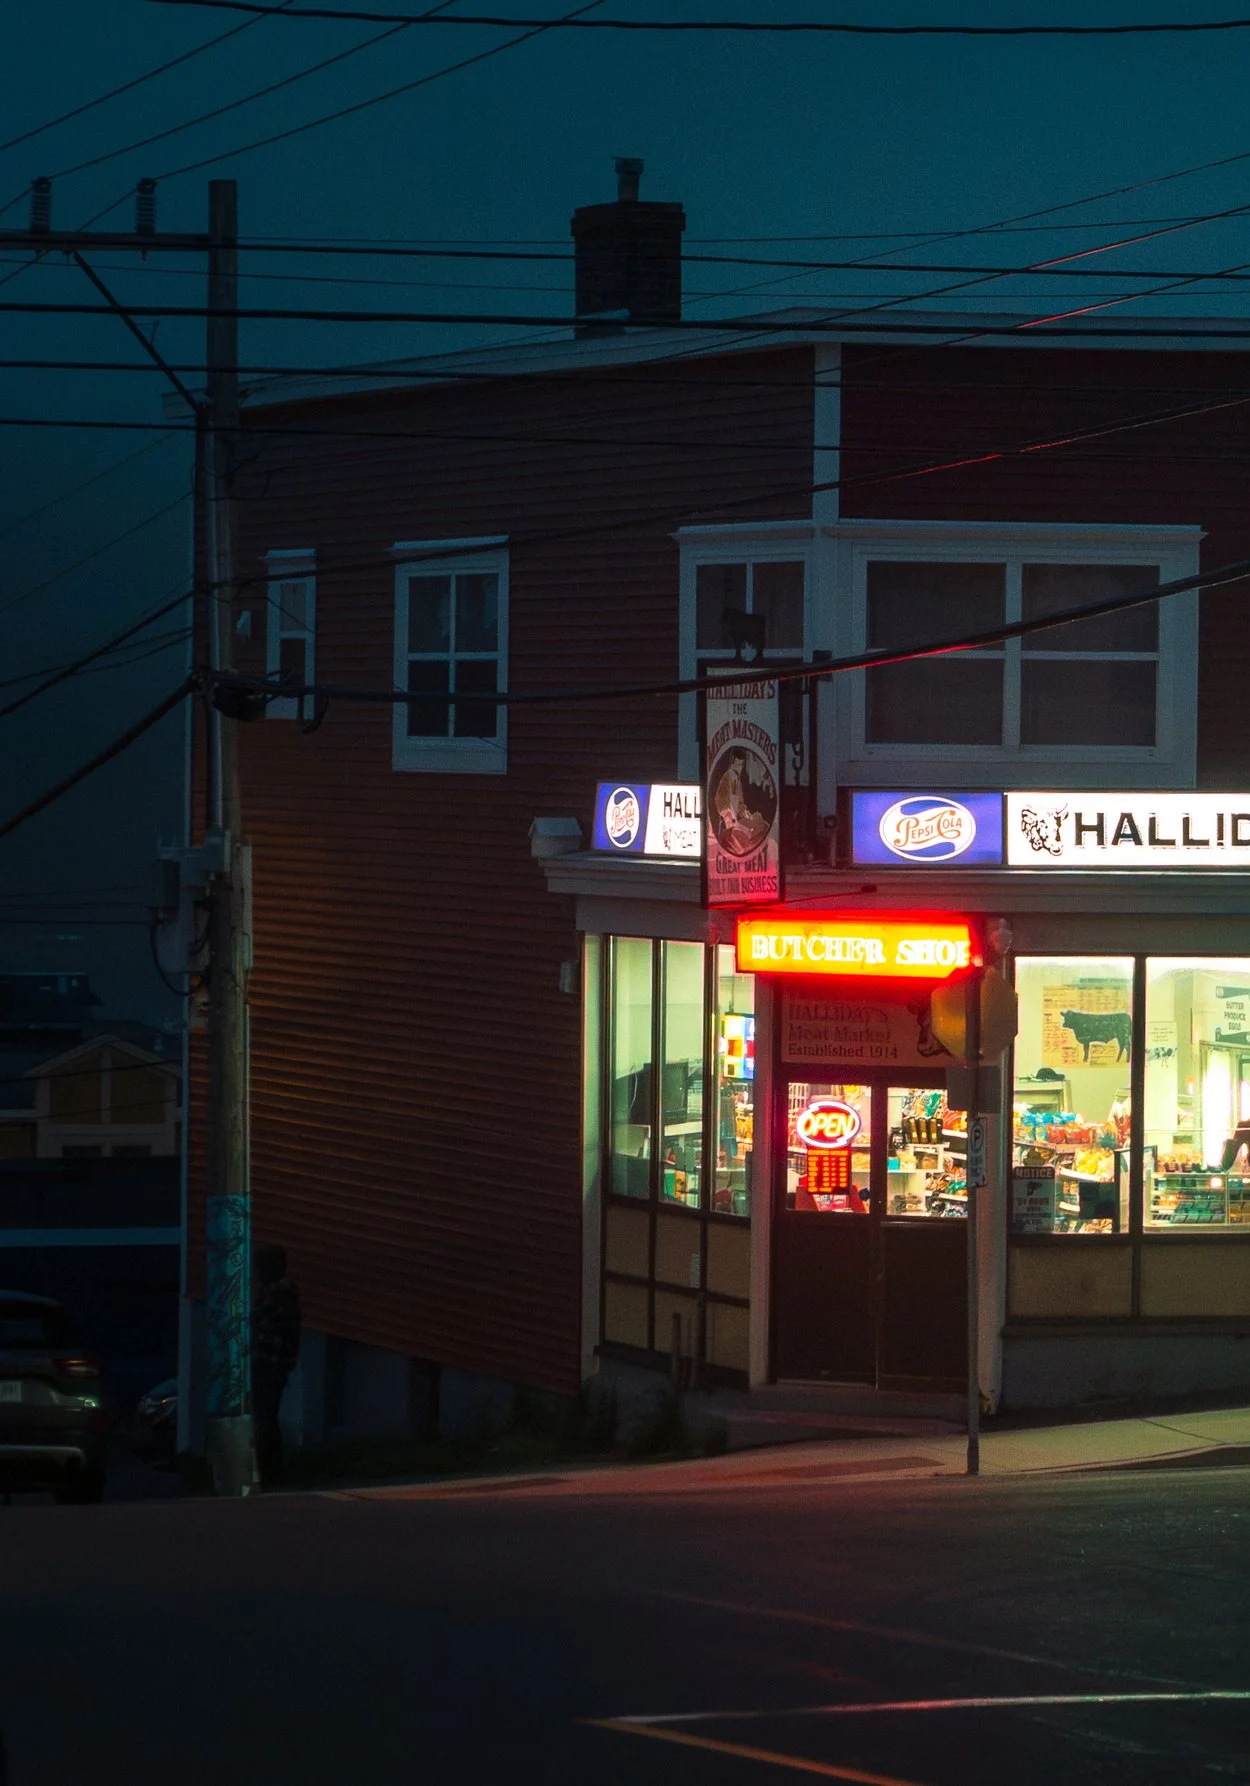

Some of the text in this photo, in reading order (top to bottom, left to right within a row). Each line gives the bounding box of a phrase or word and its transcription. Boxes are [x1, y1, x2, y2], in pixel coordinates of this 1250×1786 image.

[732, 703, 748, 715] THE
[751, 934, 886, 963] BUTCHER
[1224, 1011, 1246, 1021] PRODUCE
[789, 1043, 898, 1058] Established 1914
[802, 1112, 854, 1137] OPEN
[1015, 1168, 1053, 1179] NOTICE
